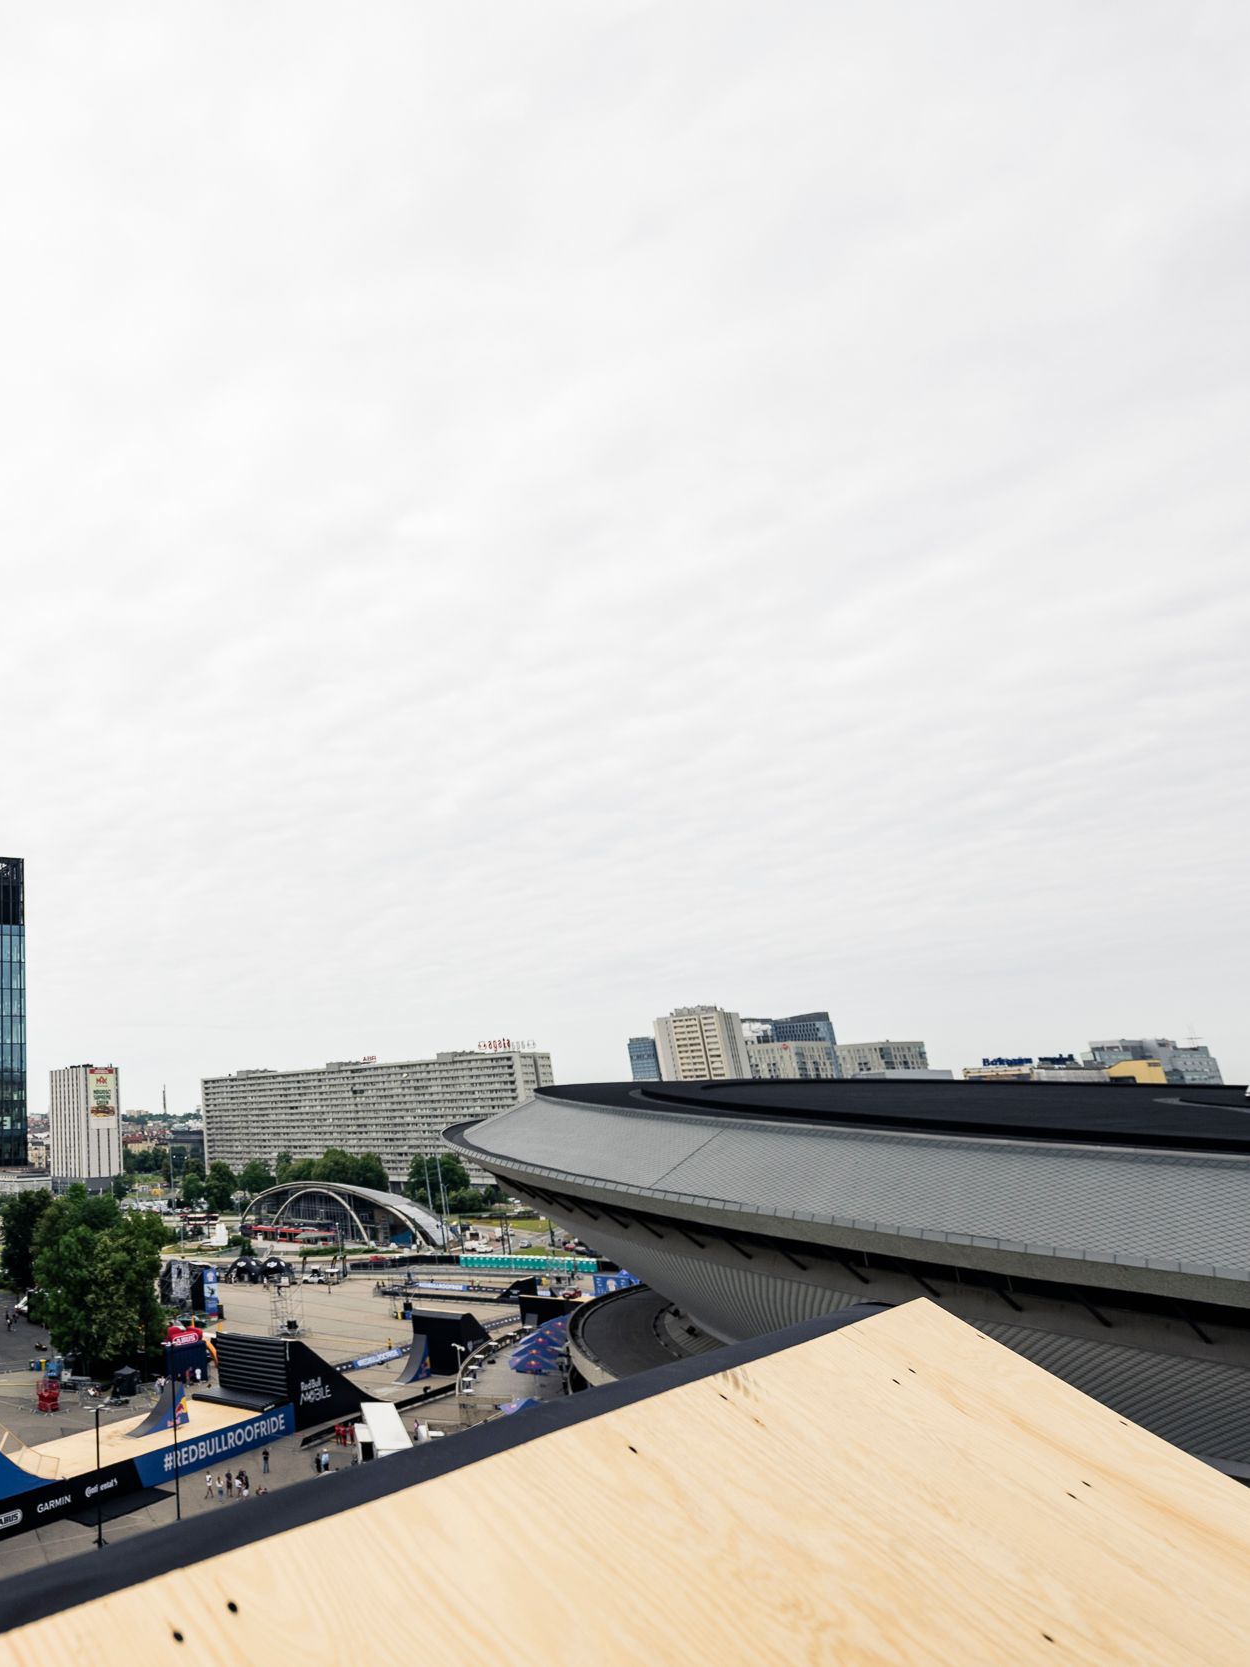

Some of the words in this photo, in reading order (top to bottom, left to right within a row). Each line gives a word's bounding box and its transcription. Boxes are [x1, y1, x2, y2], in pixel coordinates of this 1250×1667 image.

[299, 1385, 332, 1406] MOBILE
[163, 1413, 286, 1472] #REDBULLROOFRIDE
[36, 1494, 72, 1514] GARMIN
